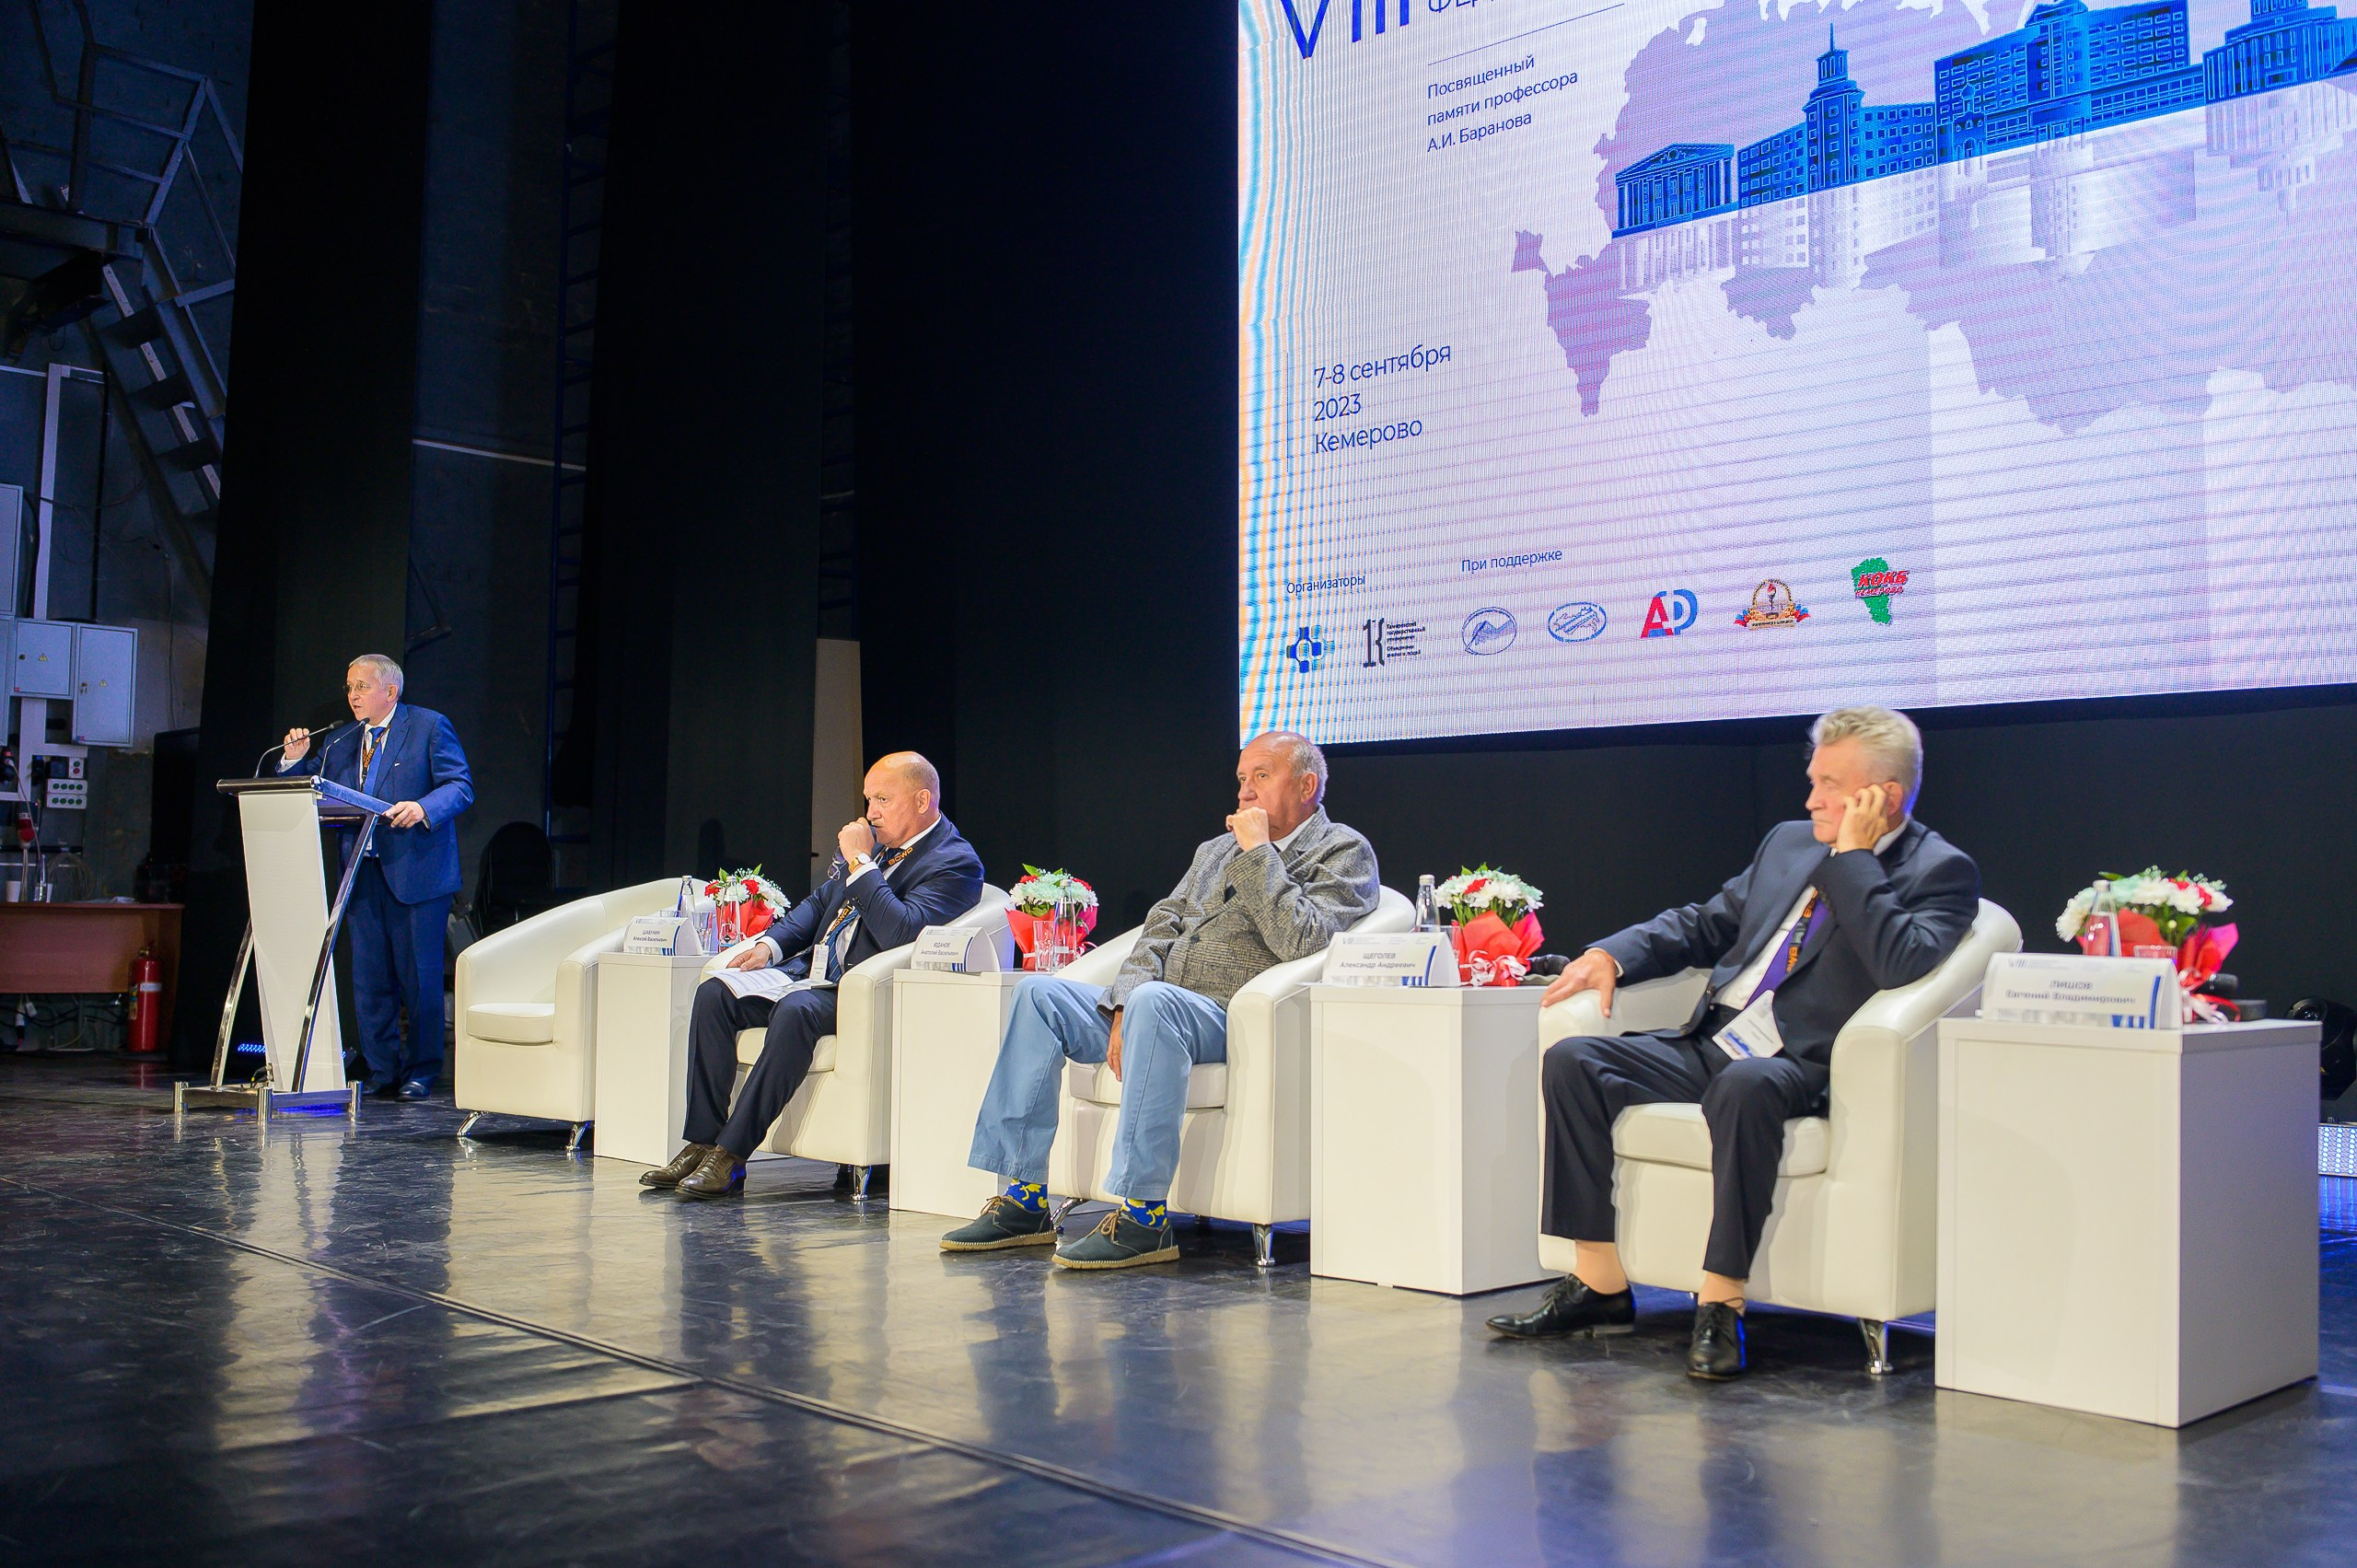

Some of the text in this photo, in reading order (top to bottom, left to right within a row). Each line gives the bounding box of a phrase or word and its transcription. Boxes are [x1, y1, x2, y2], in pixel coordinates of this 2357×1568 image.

[1428, 53, 1535, 99] Посвященный
[1428, 72, 1578, 125] памяти профессора
[1427, 113, 1532, 152] А.И. Баранова
[1314, 344, 1451, 388] 7-8 сентября
[1314, 393, 1362, 422] 2023
[1315, 420, 1422, 454] Кемерово
[1461, 550, 1562, 574] При поддержке
[1286, 575, 1365, 596] Организаторы
